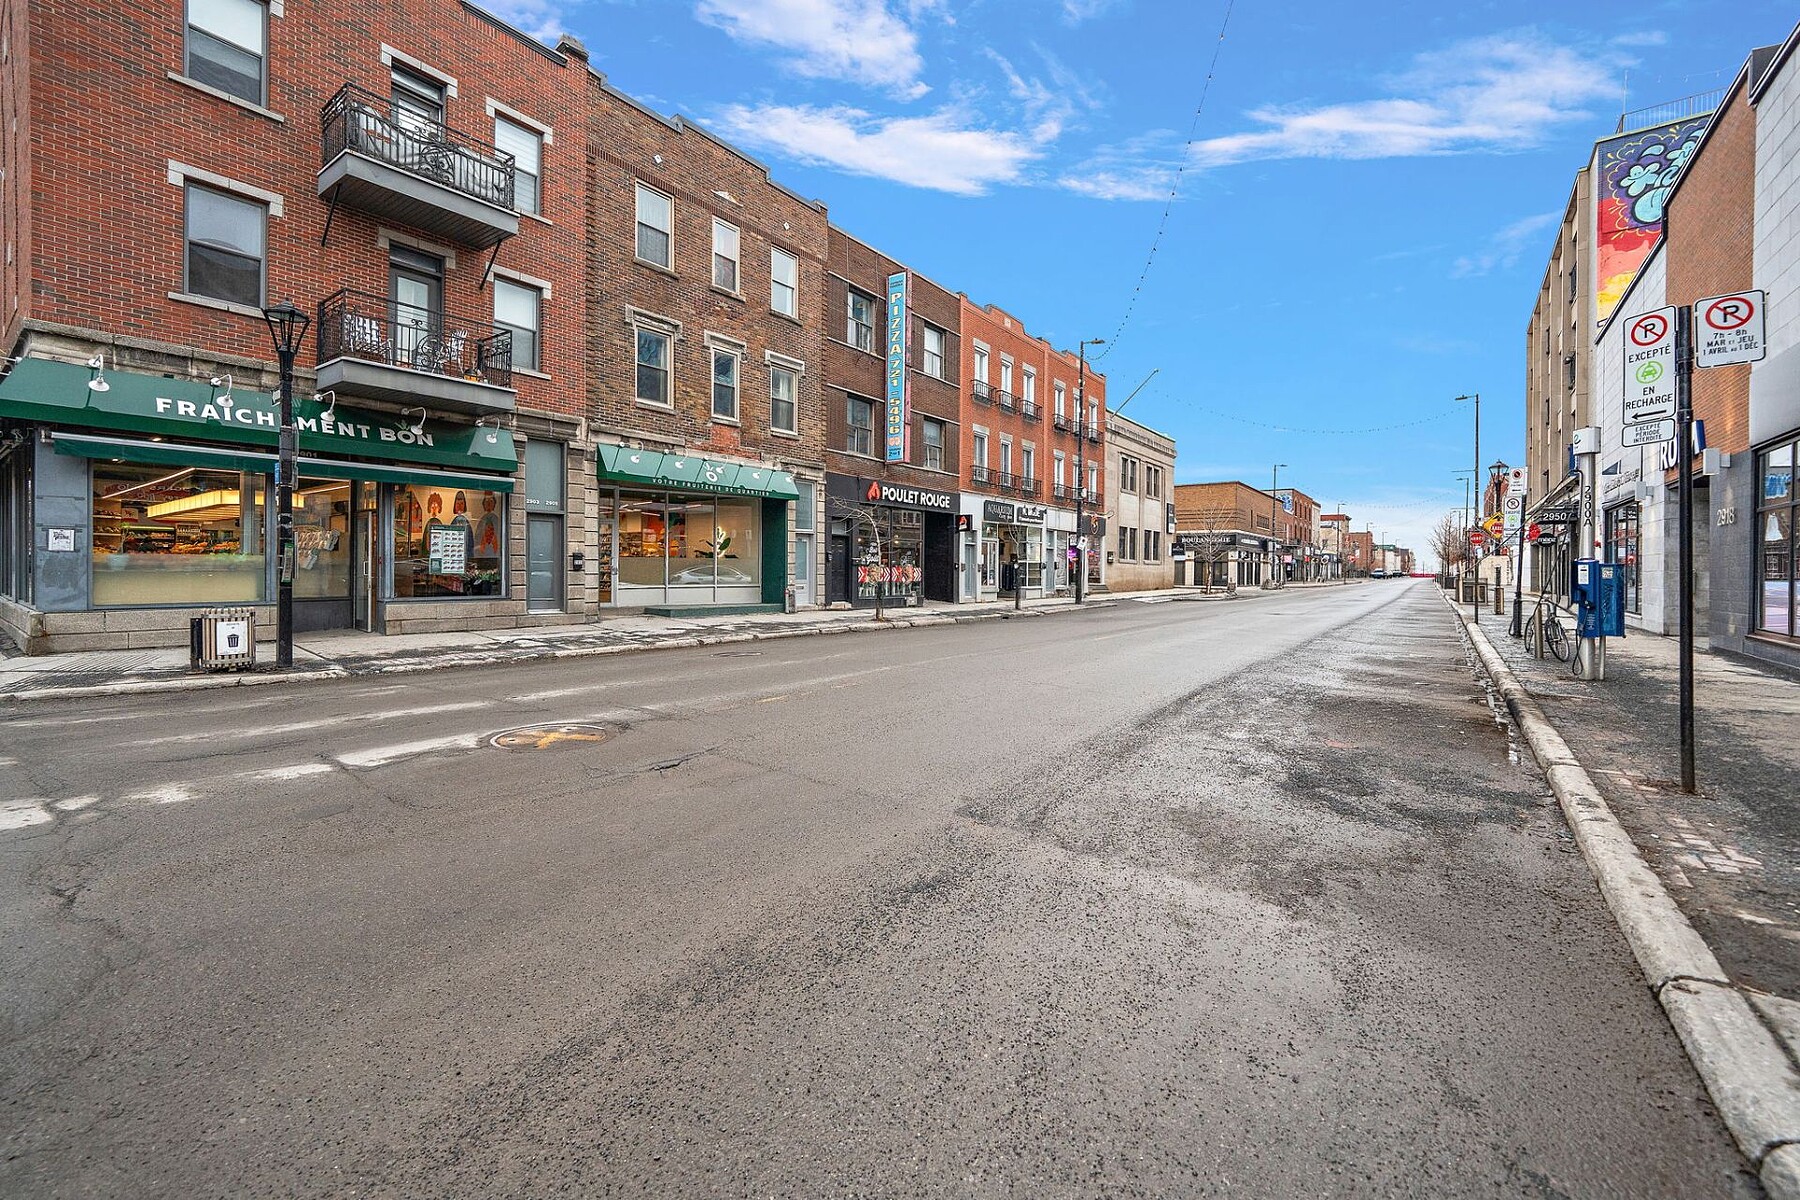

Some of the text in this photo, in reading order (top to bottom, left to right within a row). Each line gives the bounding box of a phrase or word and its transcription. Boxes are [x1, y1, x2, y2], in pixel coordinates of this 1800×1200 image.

[890, 292, 902, 355] PIZZA
[1706, 339, 1726, 348] MAR
[1737, 335, 1755, 344] JEU
[1628, 344, 1671, 363] EXCEPTÉ
[1708, 347, 1728, 355] AVRIL
[1642, 386, 1655, 396] EN
[1625, 393, 1674, 411] RECHARGE
[379, 427, 434, 447] BON
[1659, 420, 1704, 471] RO
[653, 478, 678, 486] VOTRE
[682, 481, 721, 491] FRUITERIE
[737, 488, 769, 496] QUARTIER
[882, 486, 951, 508] POULET ROUGE
[1584, 485, 1592, 527] 2900A
[1543, 512, 1567, 521] 2950
[1717, 508, 1735, 526] 2918
